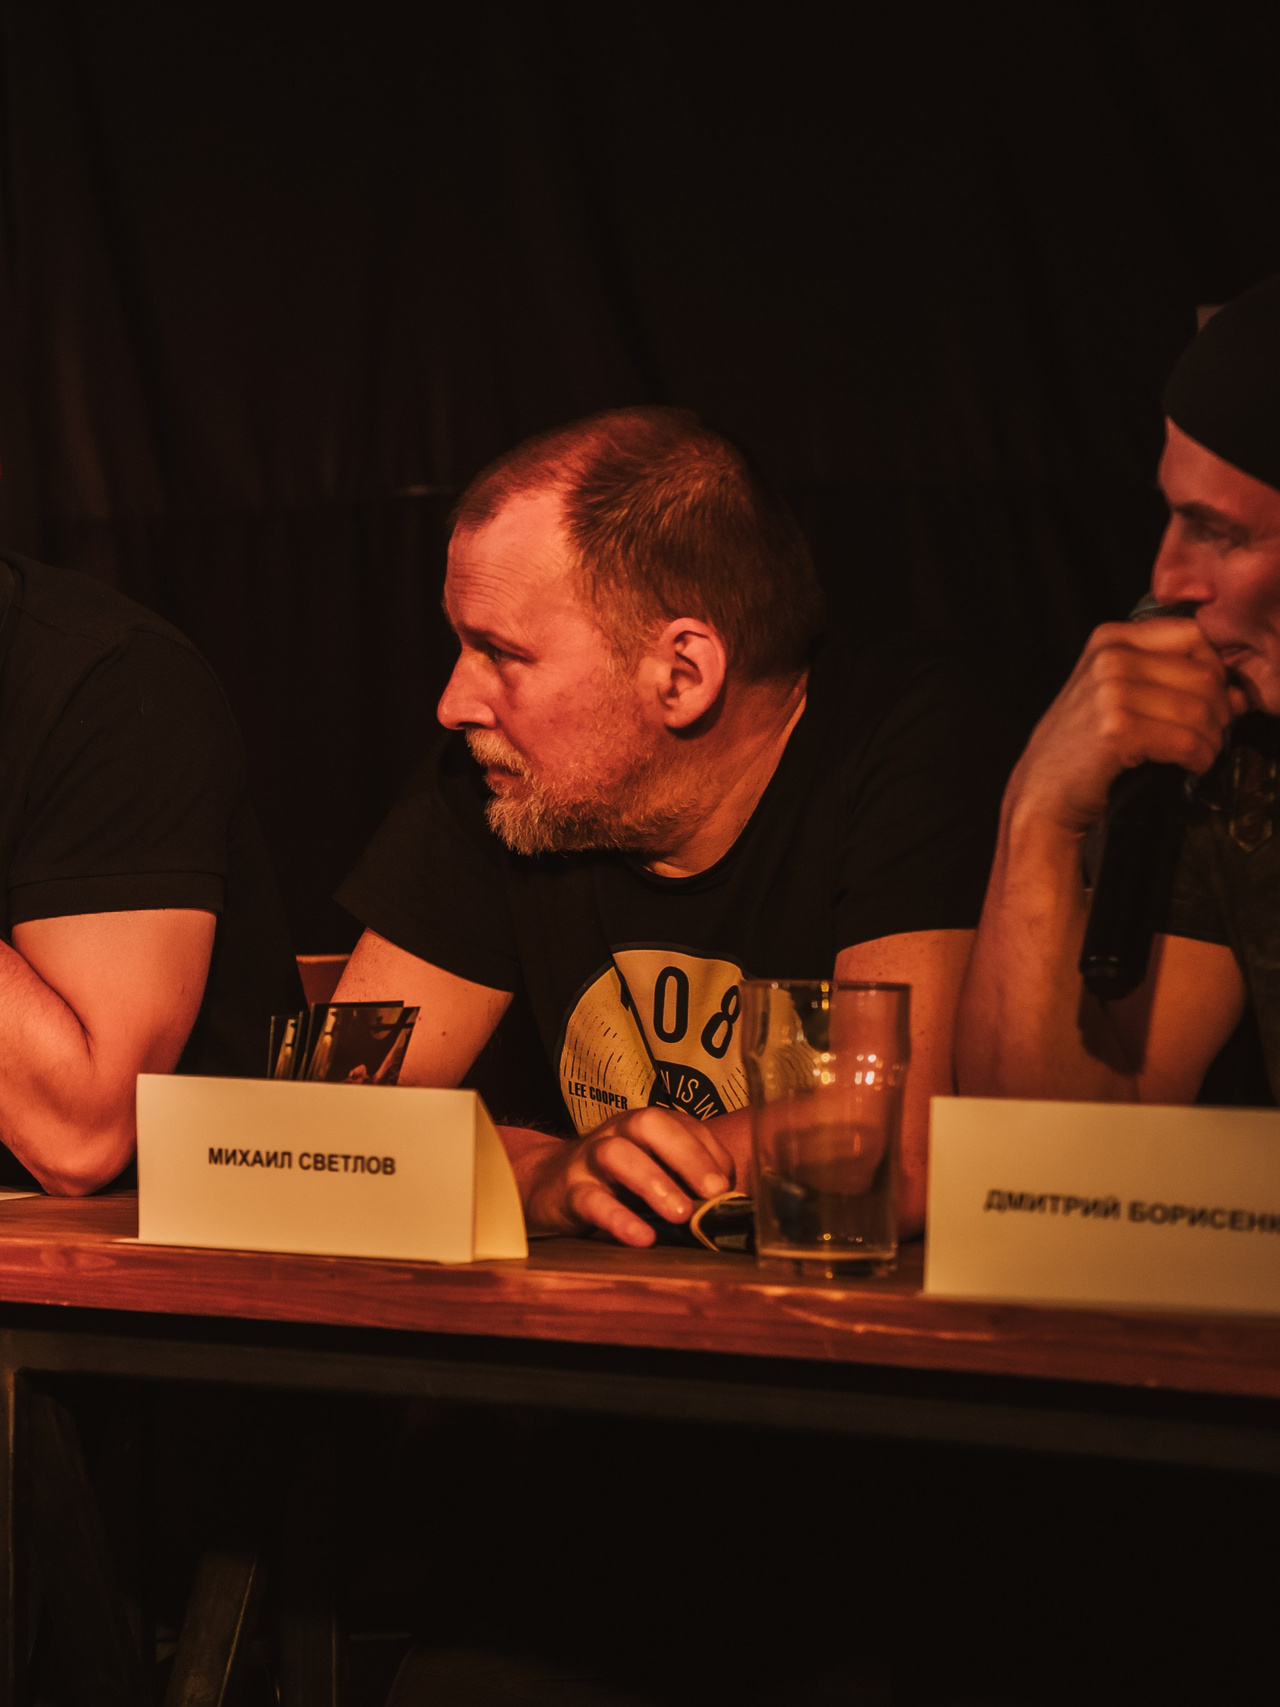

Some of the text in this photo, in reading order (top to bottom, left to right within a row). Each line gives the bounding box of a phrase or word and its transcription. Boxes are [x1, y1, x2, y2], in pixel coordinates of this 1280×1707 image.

[568, 1080, 628, 1111] LEE COOPER
[675, 1074, 699, 1103] IS
[208, 1147, 397, 1176] МИХАИЛ СВЕТЛОВ
[983, 1189, 1122, 1220] ДМИТРИЙ
